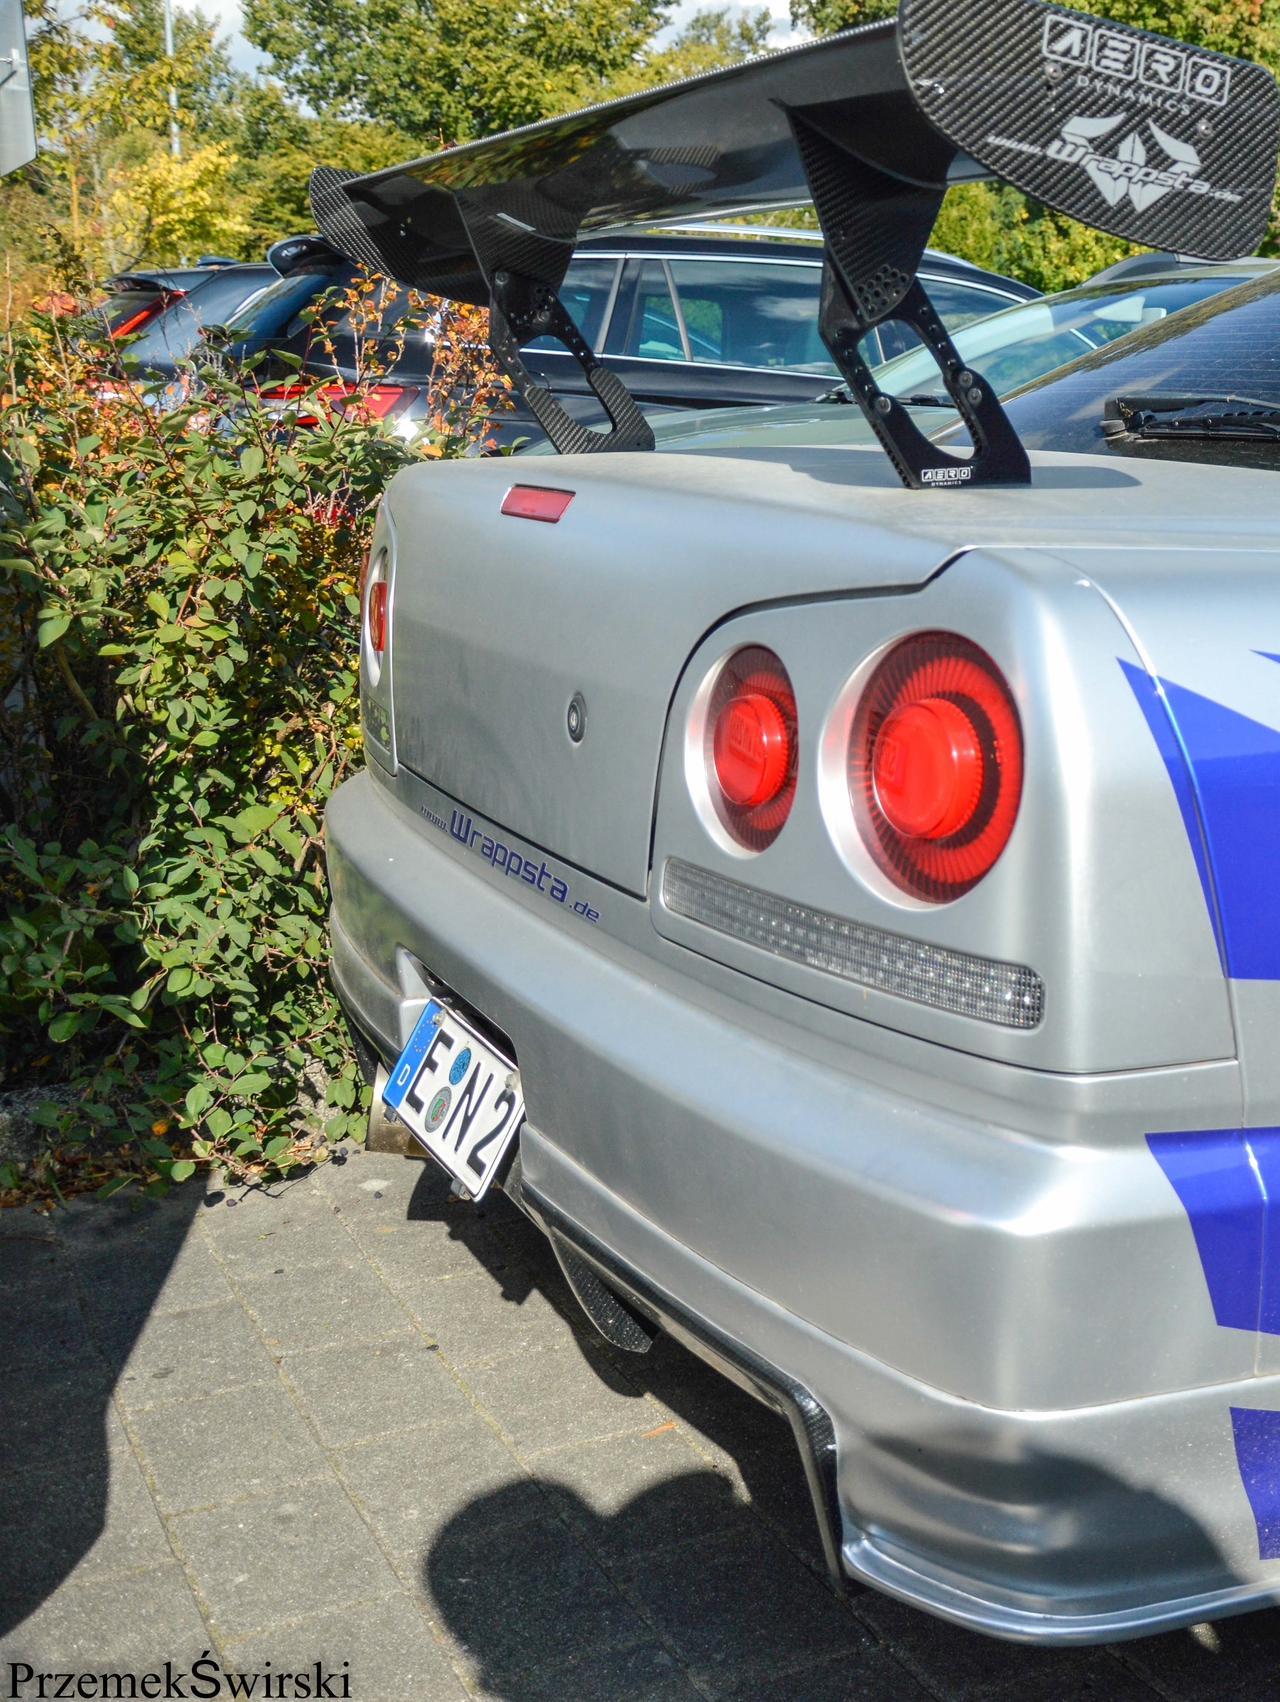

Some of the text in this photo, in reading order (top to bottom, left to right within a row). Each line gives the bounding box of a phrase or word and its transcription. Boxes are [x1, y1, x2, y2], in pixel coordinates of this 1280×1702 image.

[1047, 21, 1226, 101] AERO
[1076, 74, 1191, 116] DYNAMICS
[922, 468, 970, 481] AERO
[396, 1063, 411, 1087] D
